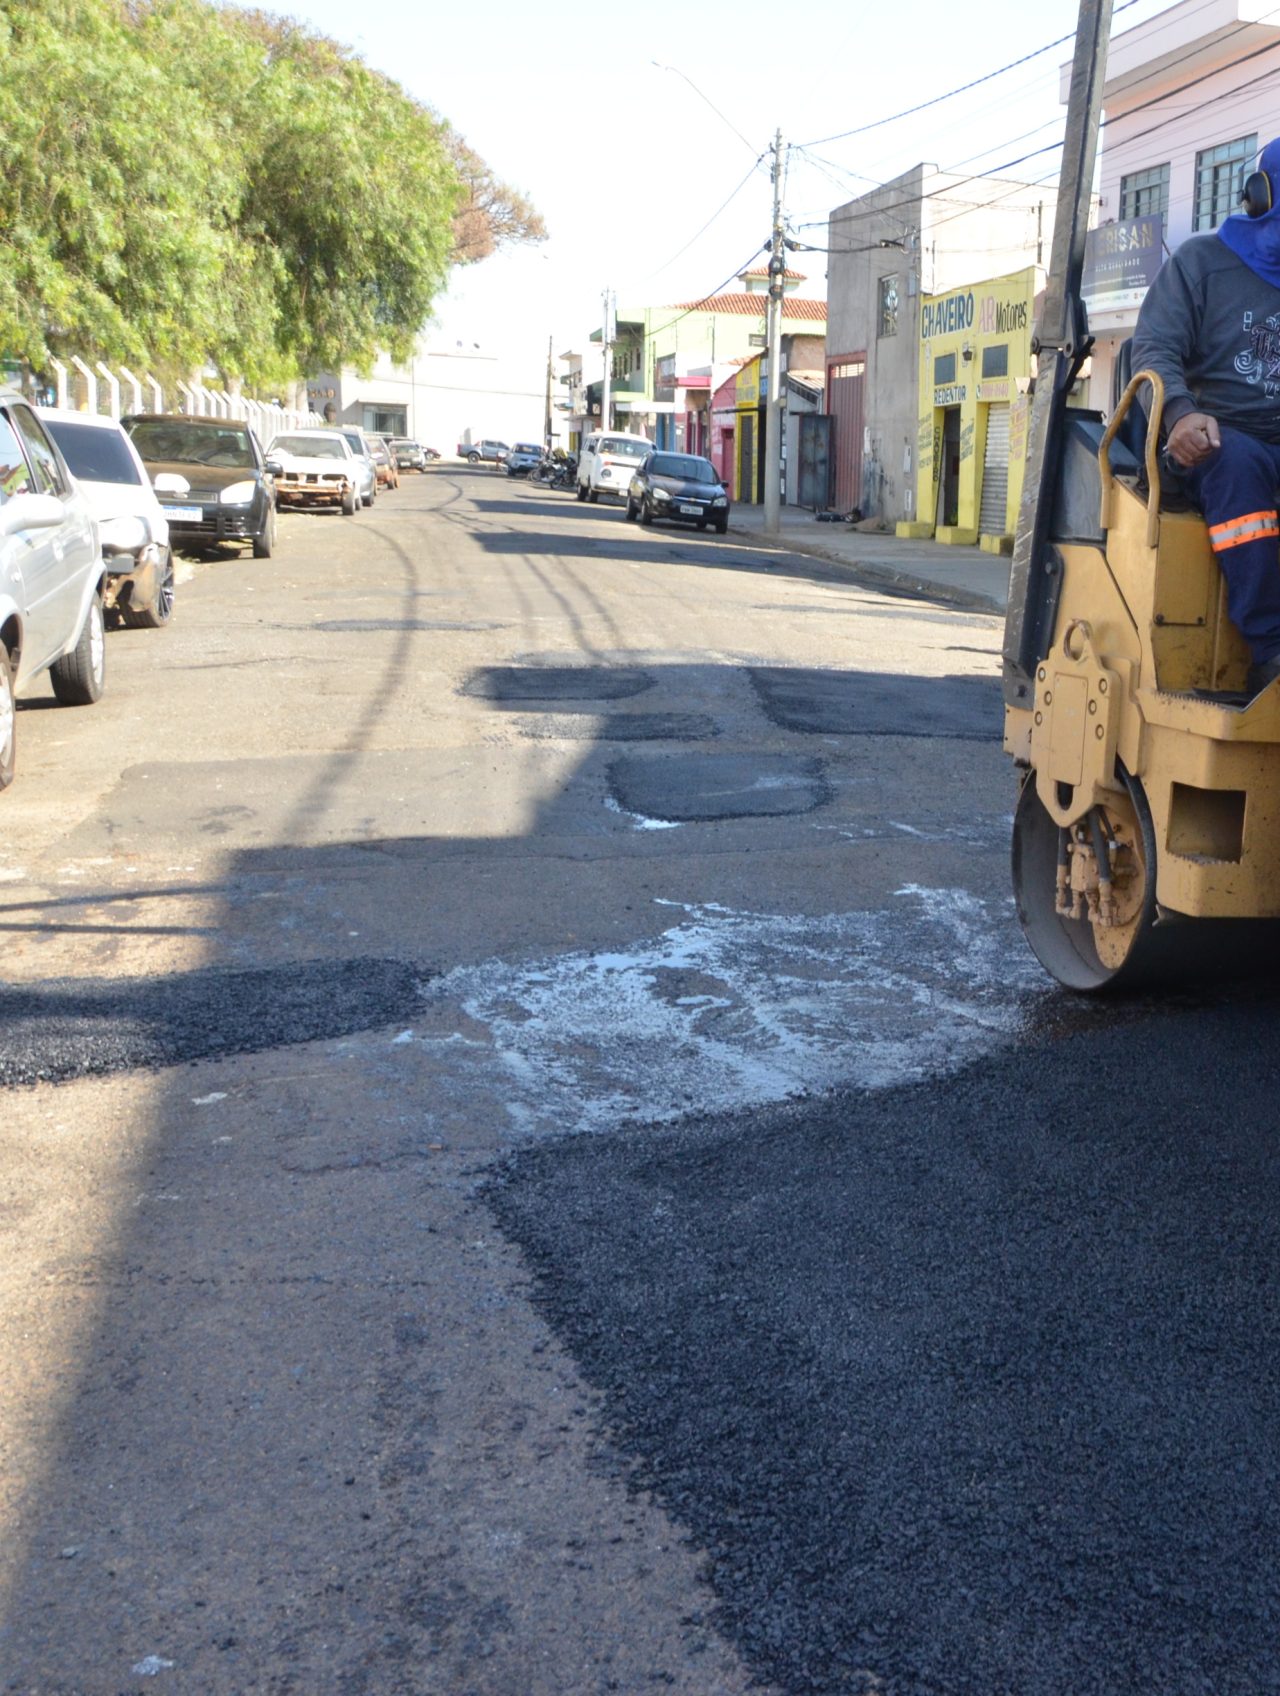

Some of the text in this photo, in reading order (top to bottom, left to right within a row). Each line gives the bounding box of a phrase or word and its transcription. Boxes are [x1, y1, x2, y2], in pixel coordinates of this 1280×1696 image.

[921, 292, 1028, 339] CHAVEIRO AR Motores
[934, 385, 966, 405] REDENTOR
